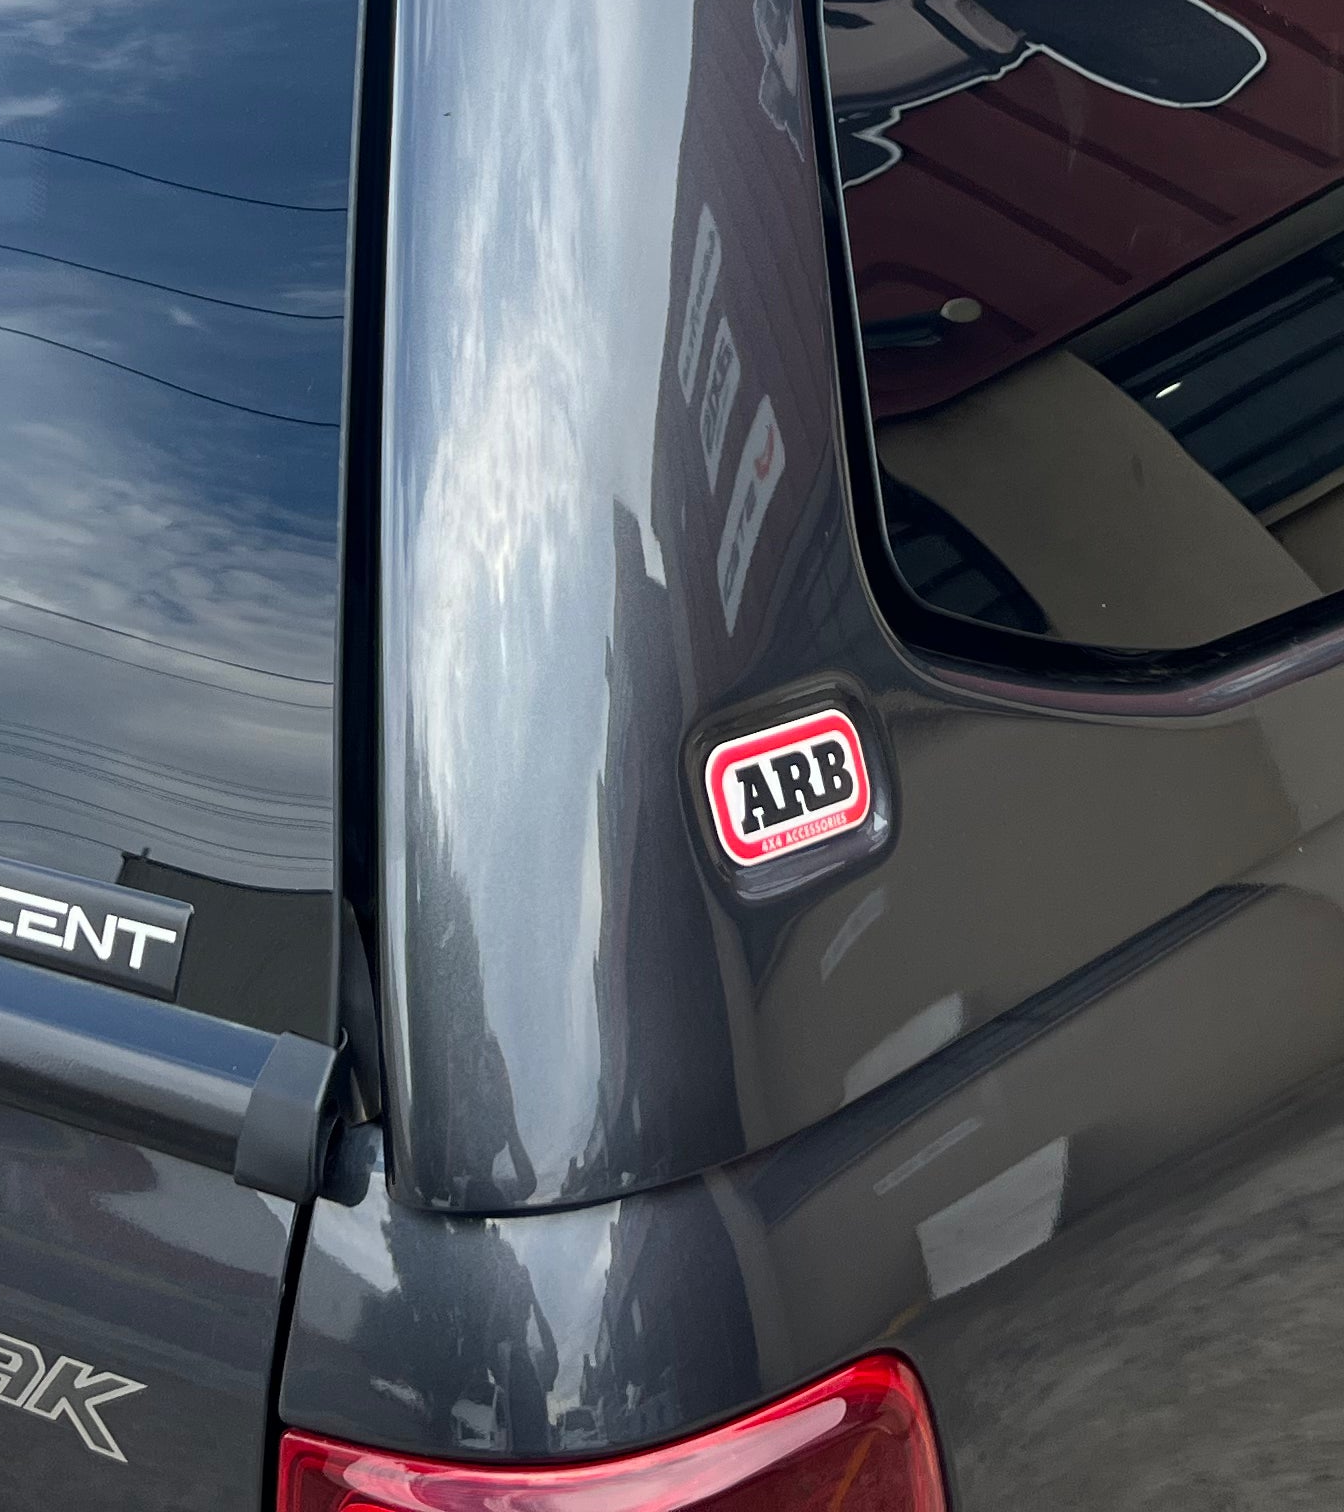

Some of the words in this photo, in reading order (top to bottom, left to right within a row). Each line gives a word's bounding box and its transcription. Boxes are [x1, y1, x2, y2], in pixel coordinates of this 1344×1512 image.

[734, 738, 854, 835] ARB
[761, 834, 783, 853] 4X4
[785, 811, 848, 845] ACCESSORIES
